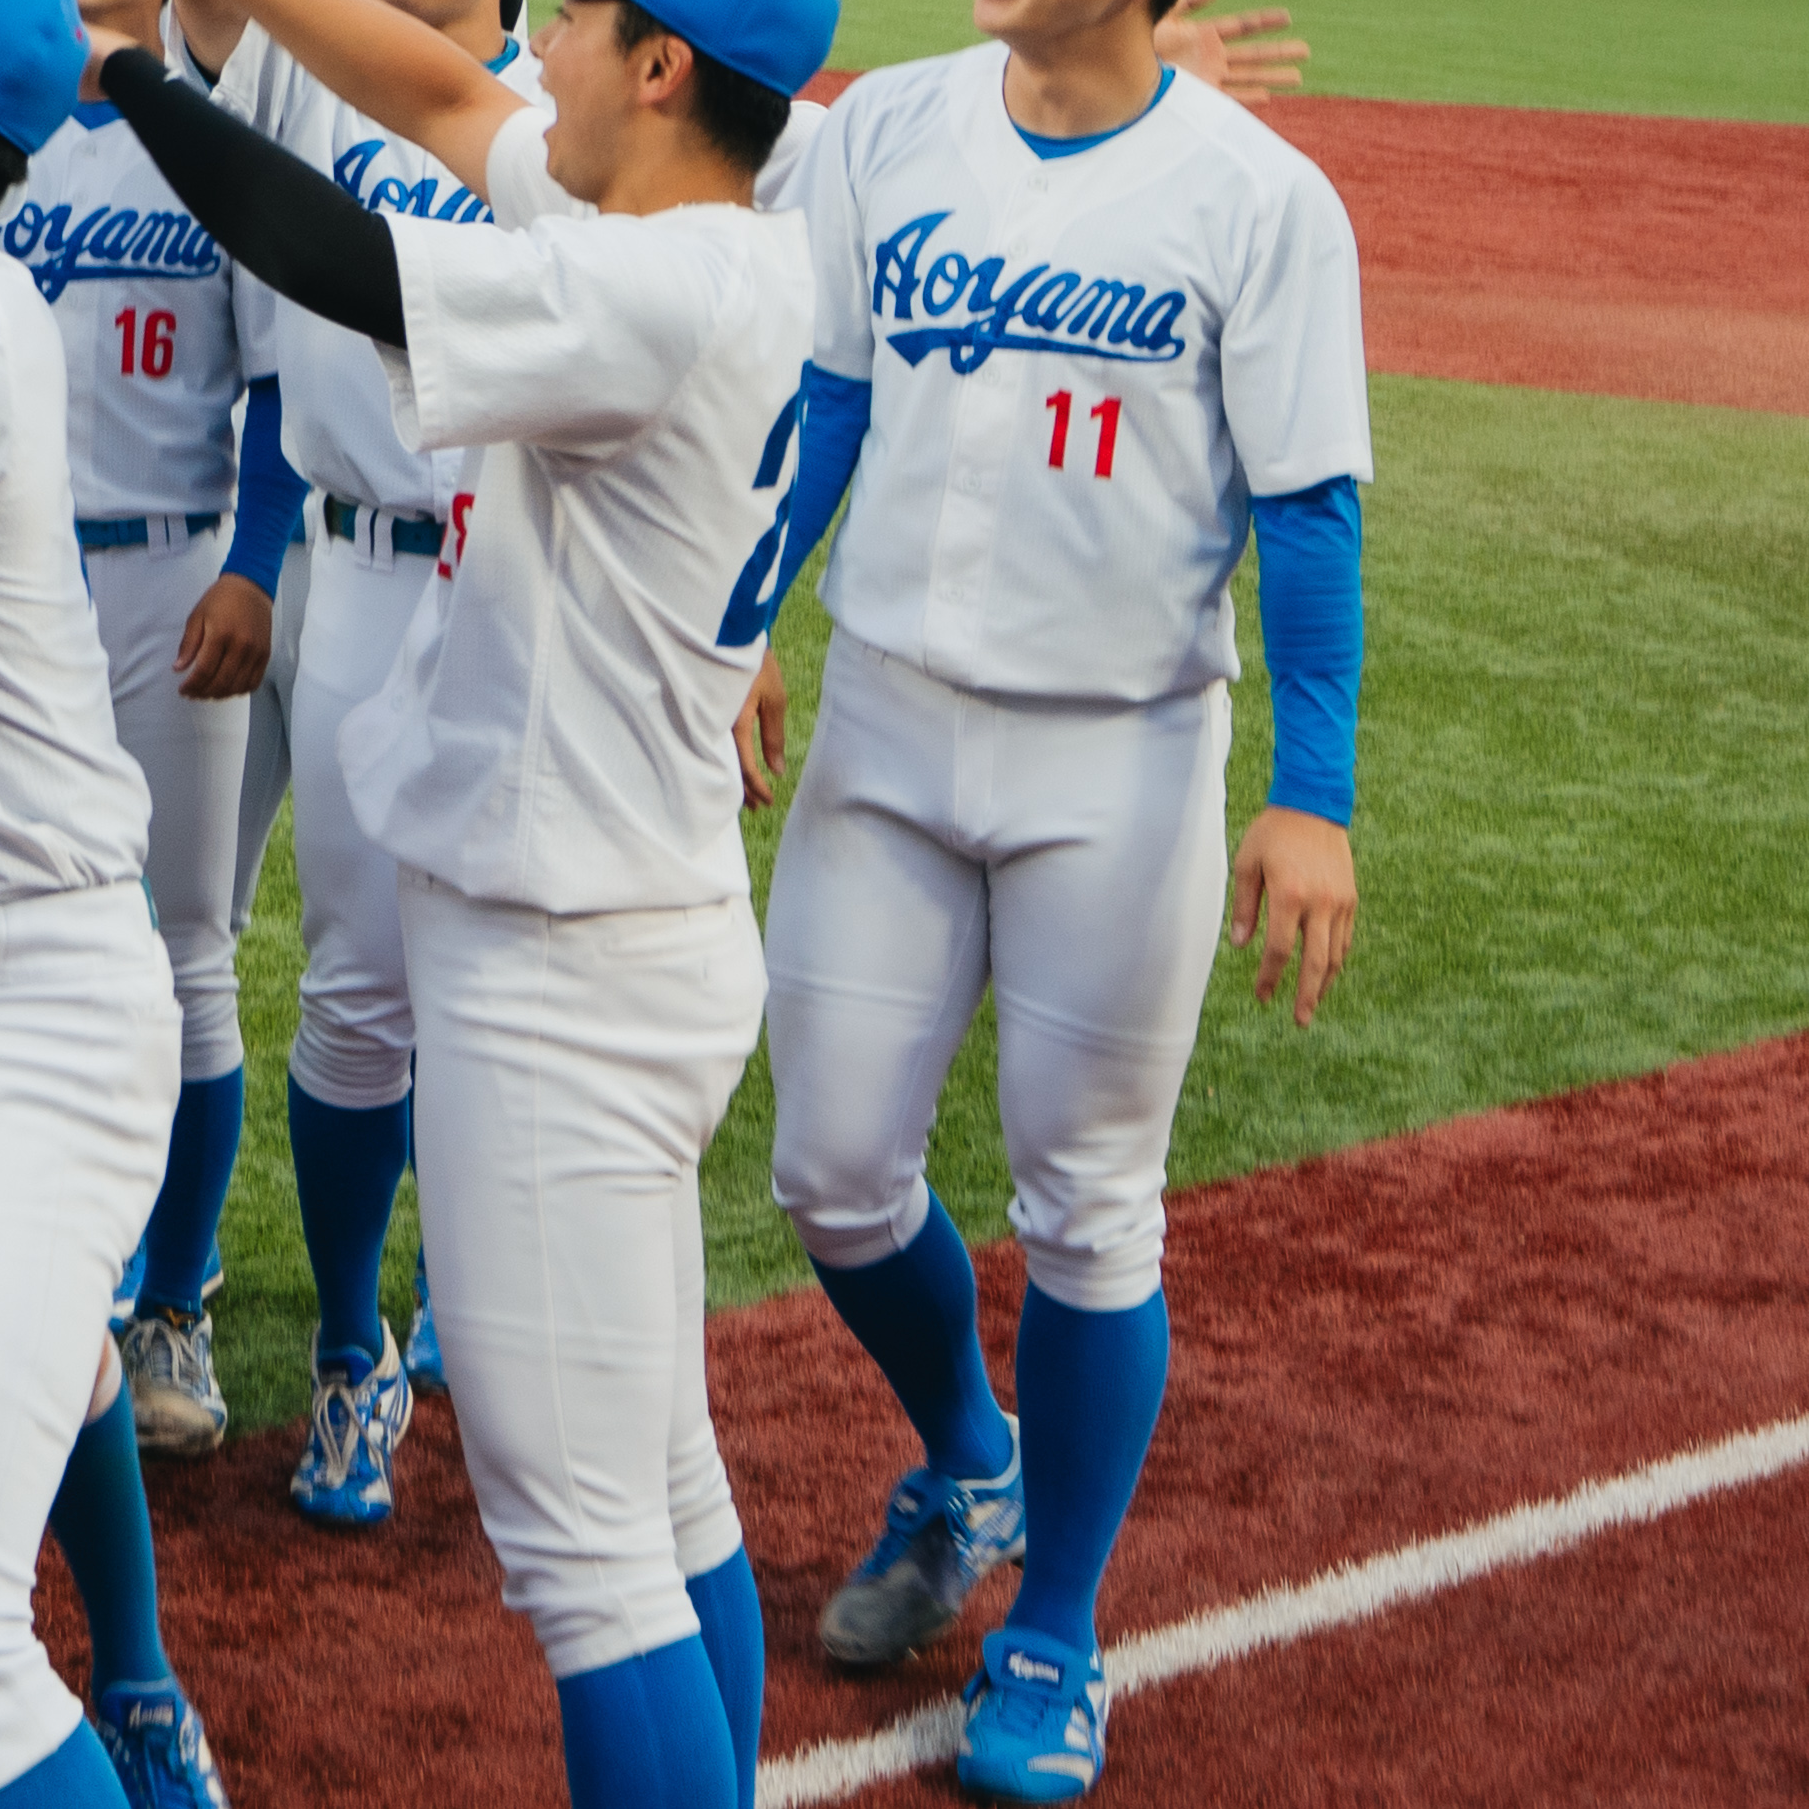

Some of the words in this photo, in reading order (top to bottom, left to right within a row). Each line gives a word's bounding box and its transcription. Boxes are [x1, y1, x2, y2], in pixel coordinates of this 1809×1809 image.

[871, 209, 1187, 375] Aoyama
[114, 305, 177, 380] 16
[1045, 387, 1122, 480] 11
